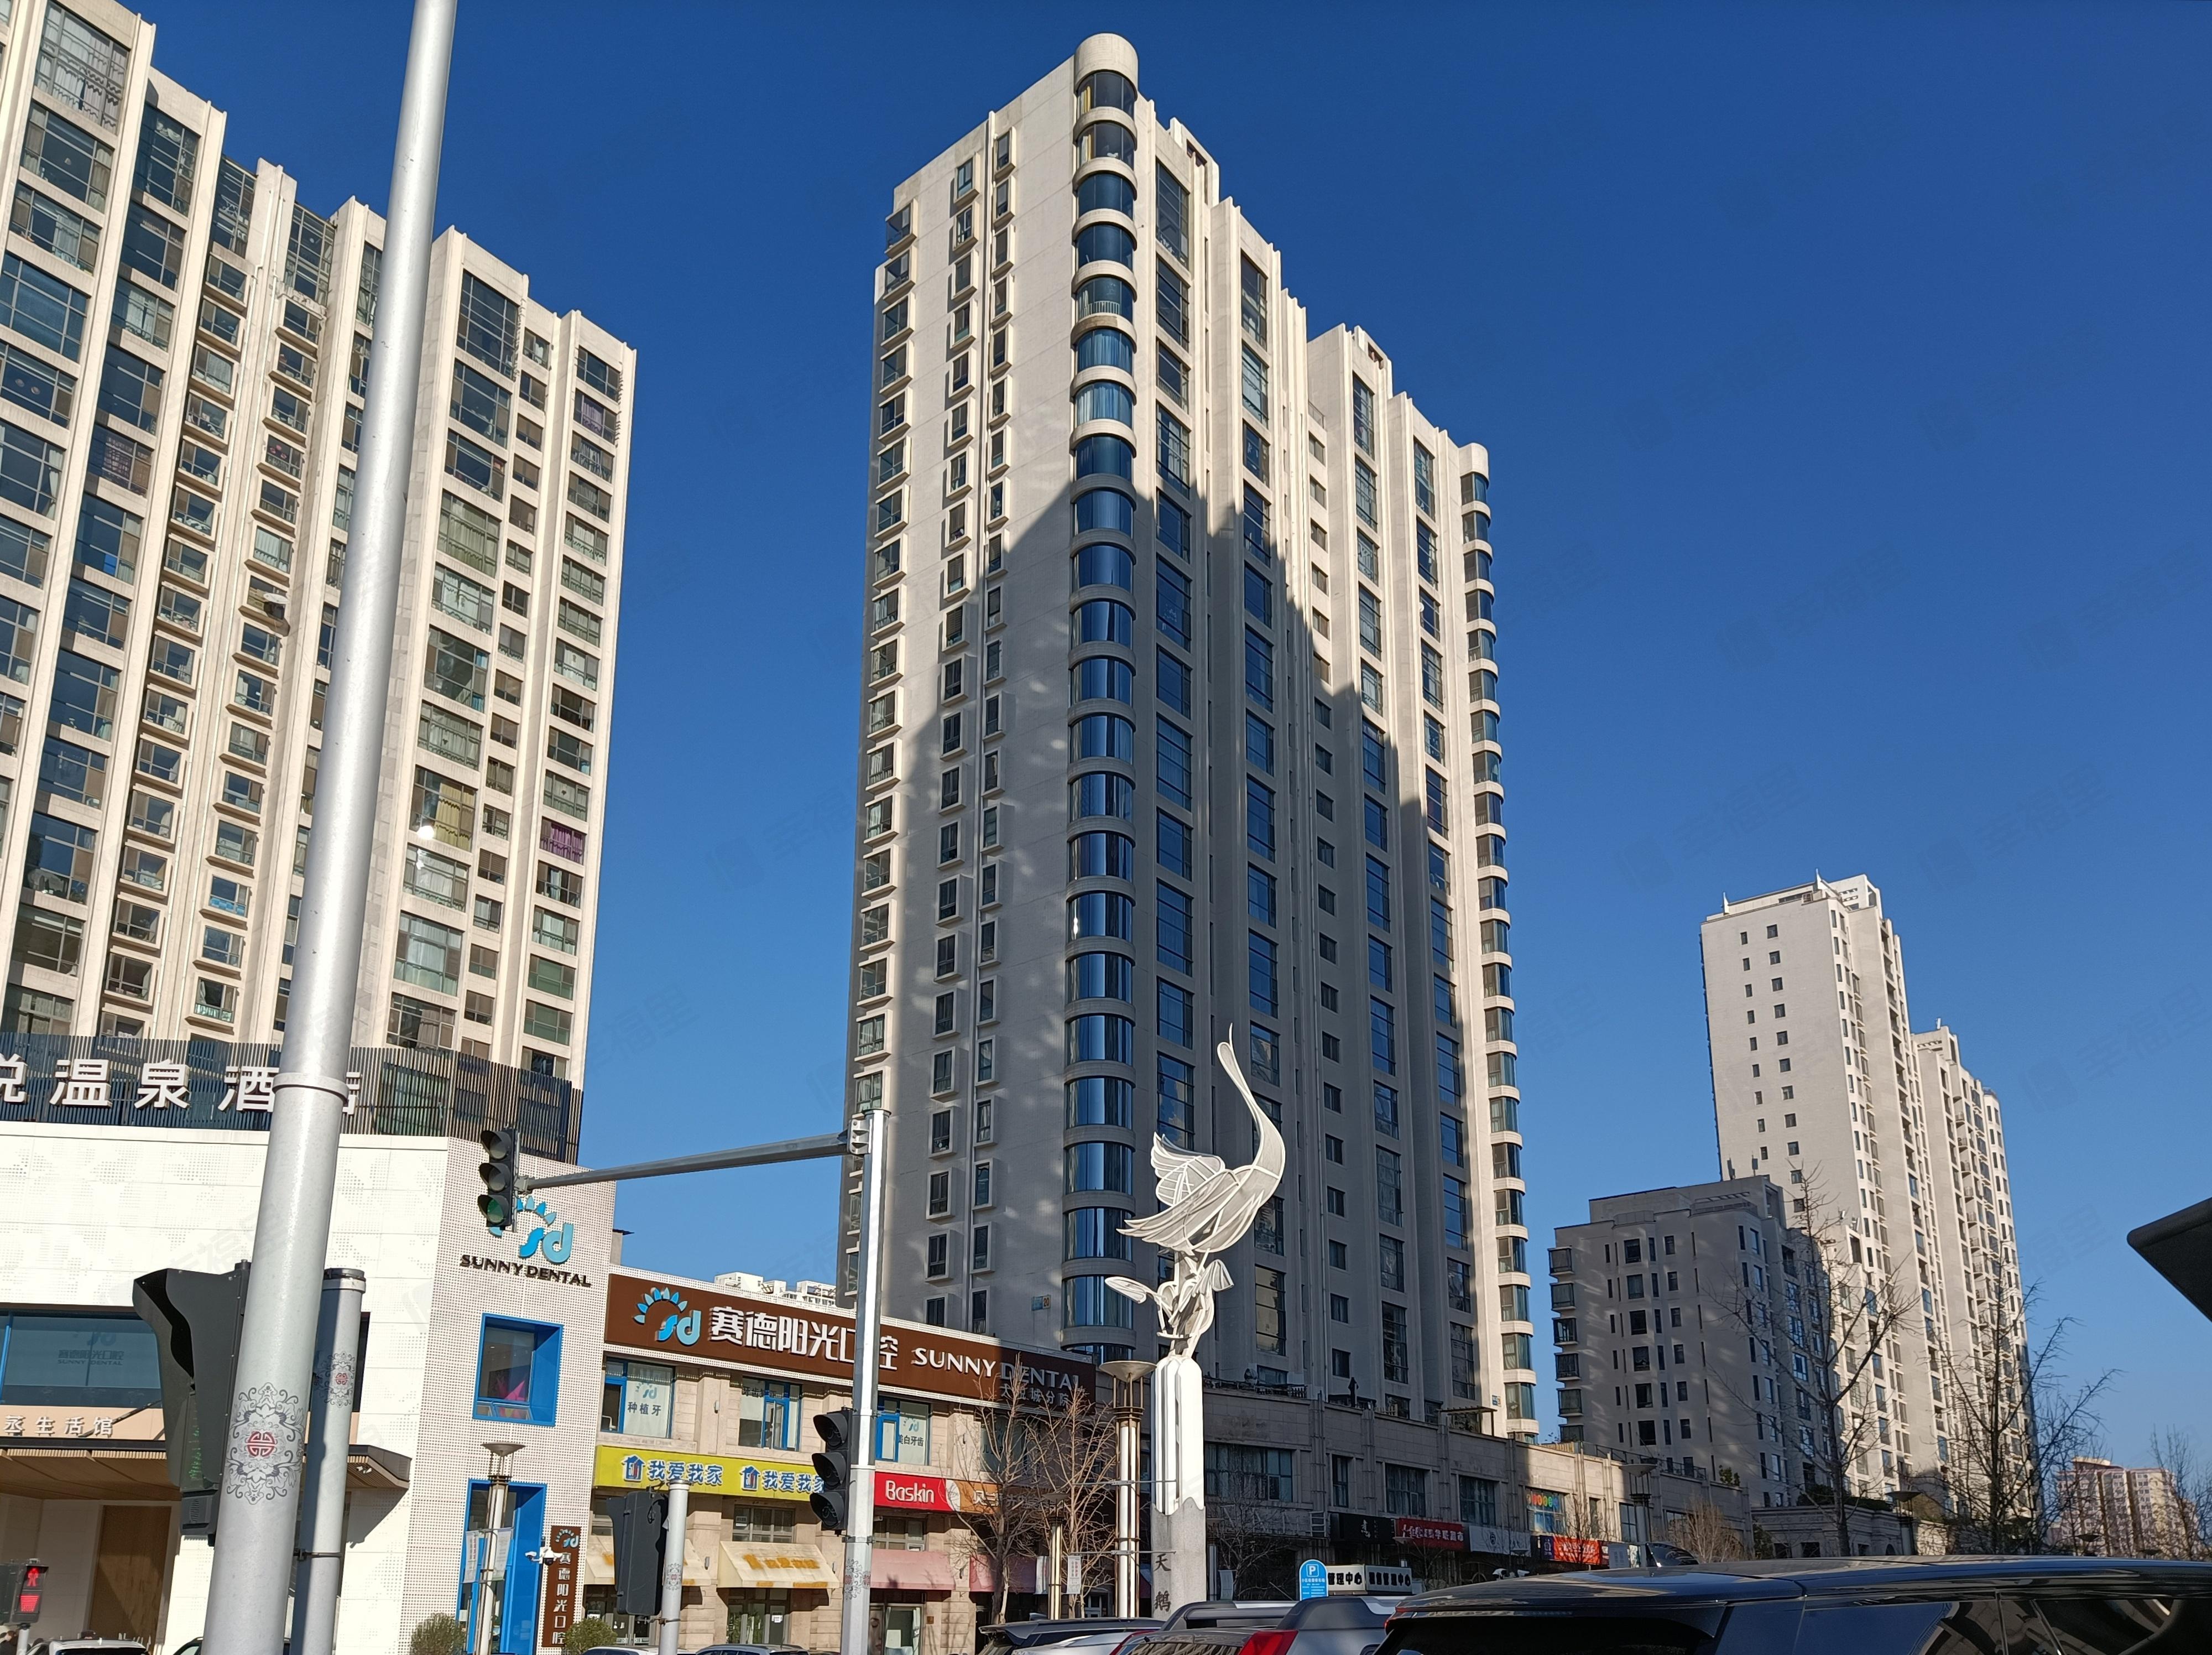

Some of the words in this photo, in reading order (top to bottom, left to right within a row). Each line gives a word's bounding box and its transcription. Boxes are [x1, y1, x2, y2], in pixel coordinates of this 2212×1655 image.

[460, 1254, 525, 1277] SUNNY
[527, 1264, 591, 1287] DENTAL
[911, 1347, 996, 1377] SUNNY
[628, 1400, 662, 1416] 种植牙
[647, 1459, 723, 1486] 我爱我家
[885, 1479, 935, 1504] Baskin
[1154, 1553, 1172, 1612] 天鹅
[551, 1552, 572, 1645] 赛德阳光口腔
